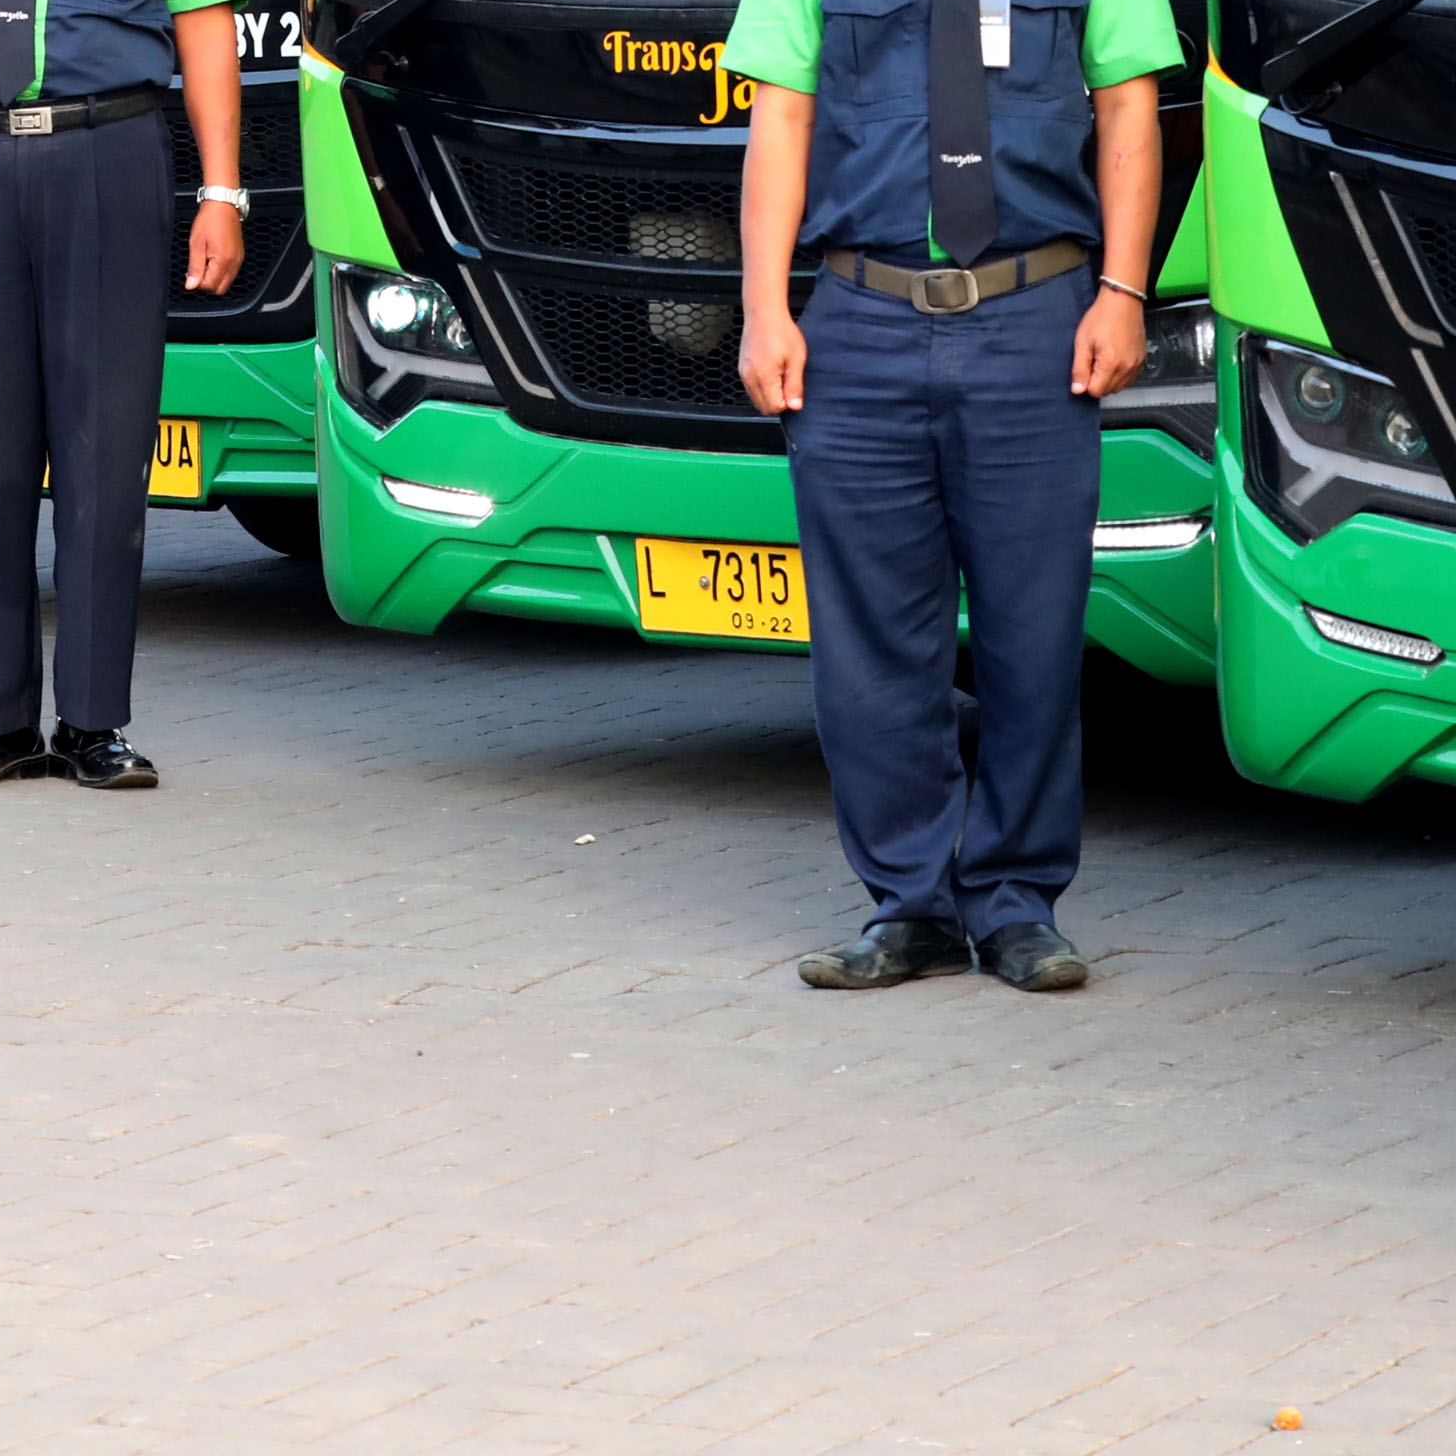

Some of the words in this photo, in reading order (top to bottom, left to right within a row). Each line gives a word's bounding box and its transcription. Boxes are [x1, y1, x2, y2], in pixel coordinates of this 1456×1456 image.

[603, 30, 697, 76] Trans
[157, 424, 193, 468] UA
[644, 545, 667, 598] L
[701, 549, 790, 605] 7315
